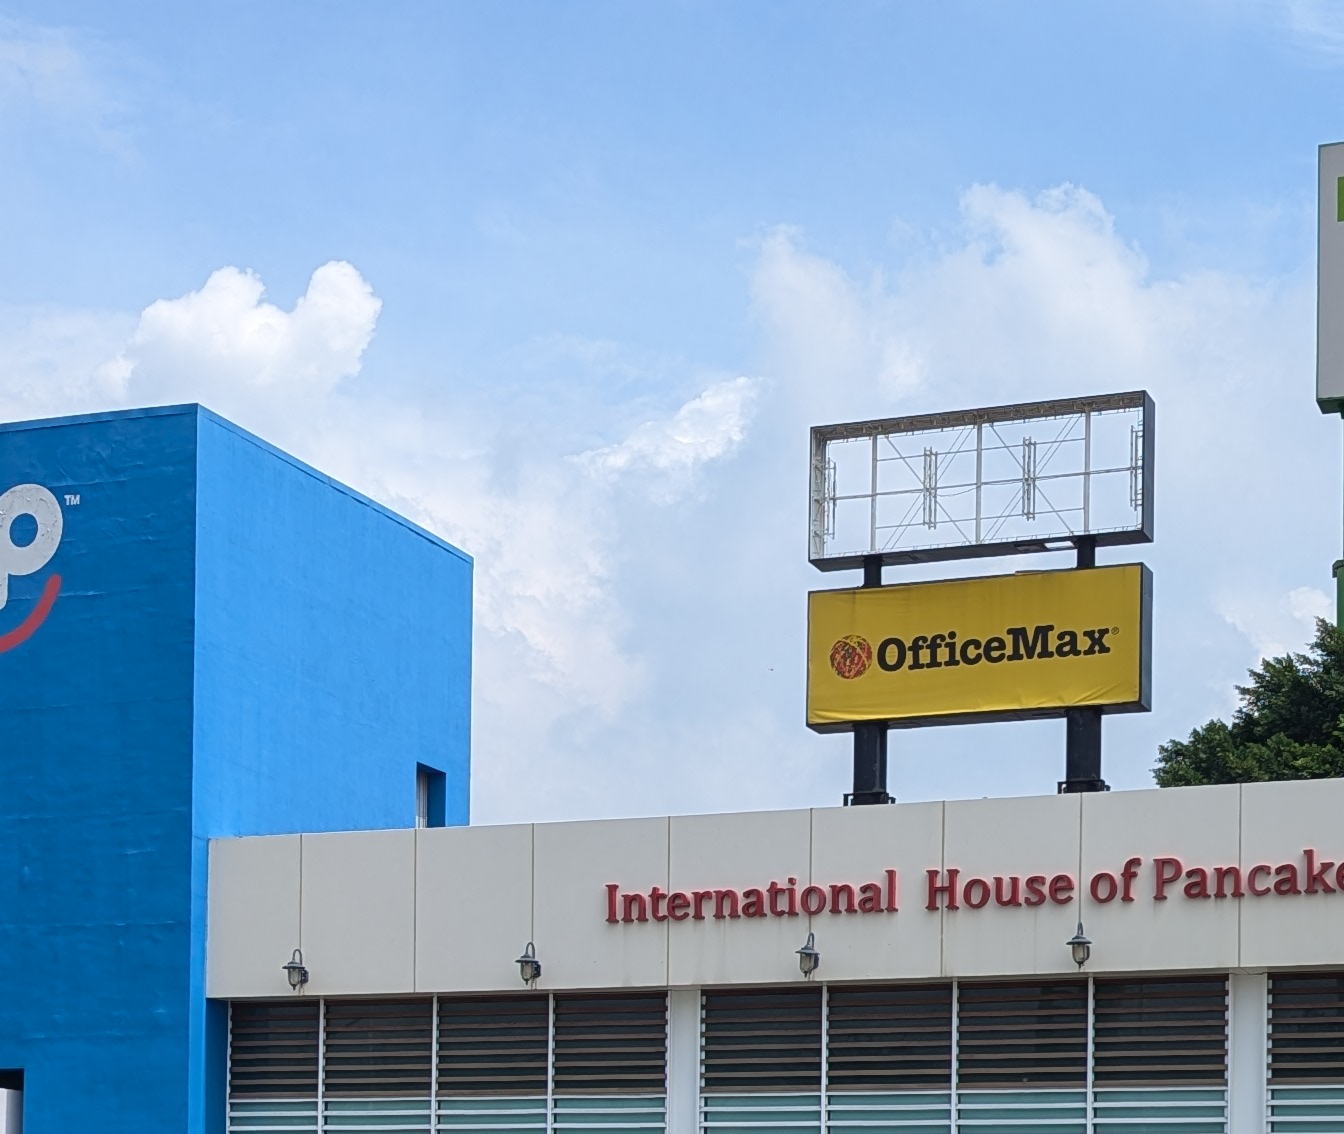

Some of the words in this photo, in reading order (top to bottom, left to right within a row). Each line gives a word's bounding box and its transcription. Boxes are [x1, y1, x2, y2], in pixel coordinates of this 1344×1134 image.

[877, 624, 1112, 672] OfficeMax
[605, 869, 899, 924] International
[925, 868, 1075, 911] House
[1089, 857, 1142, 904] of
